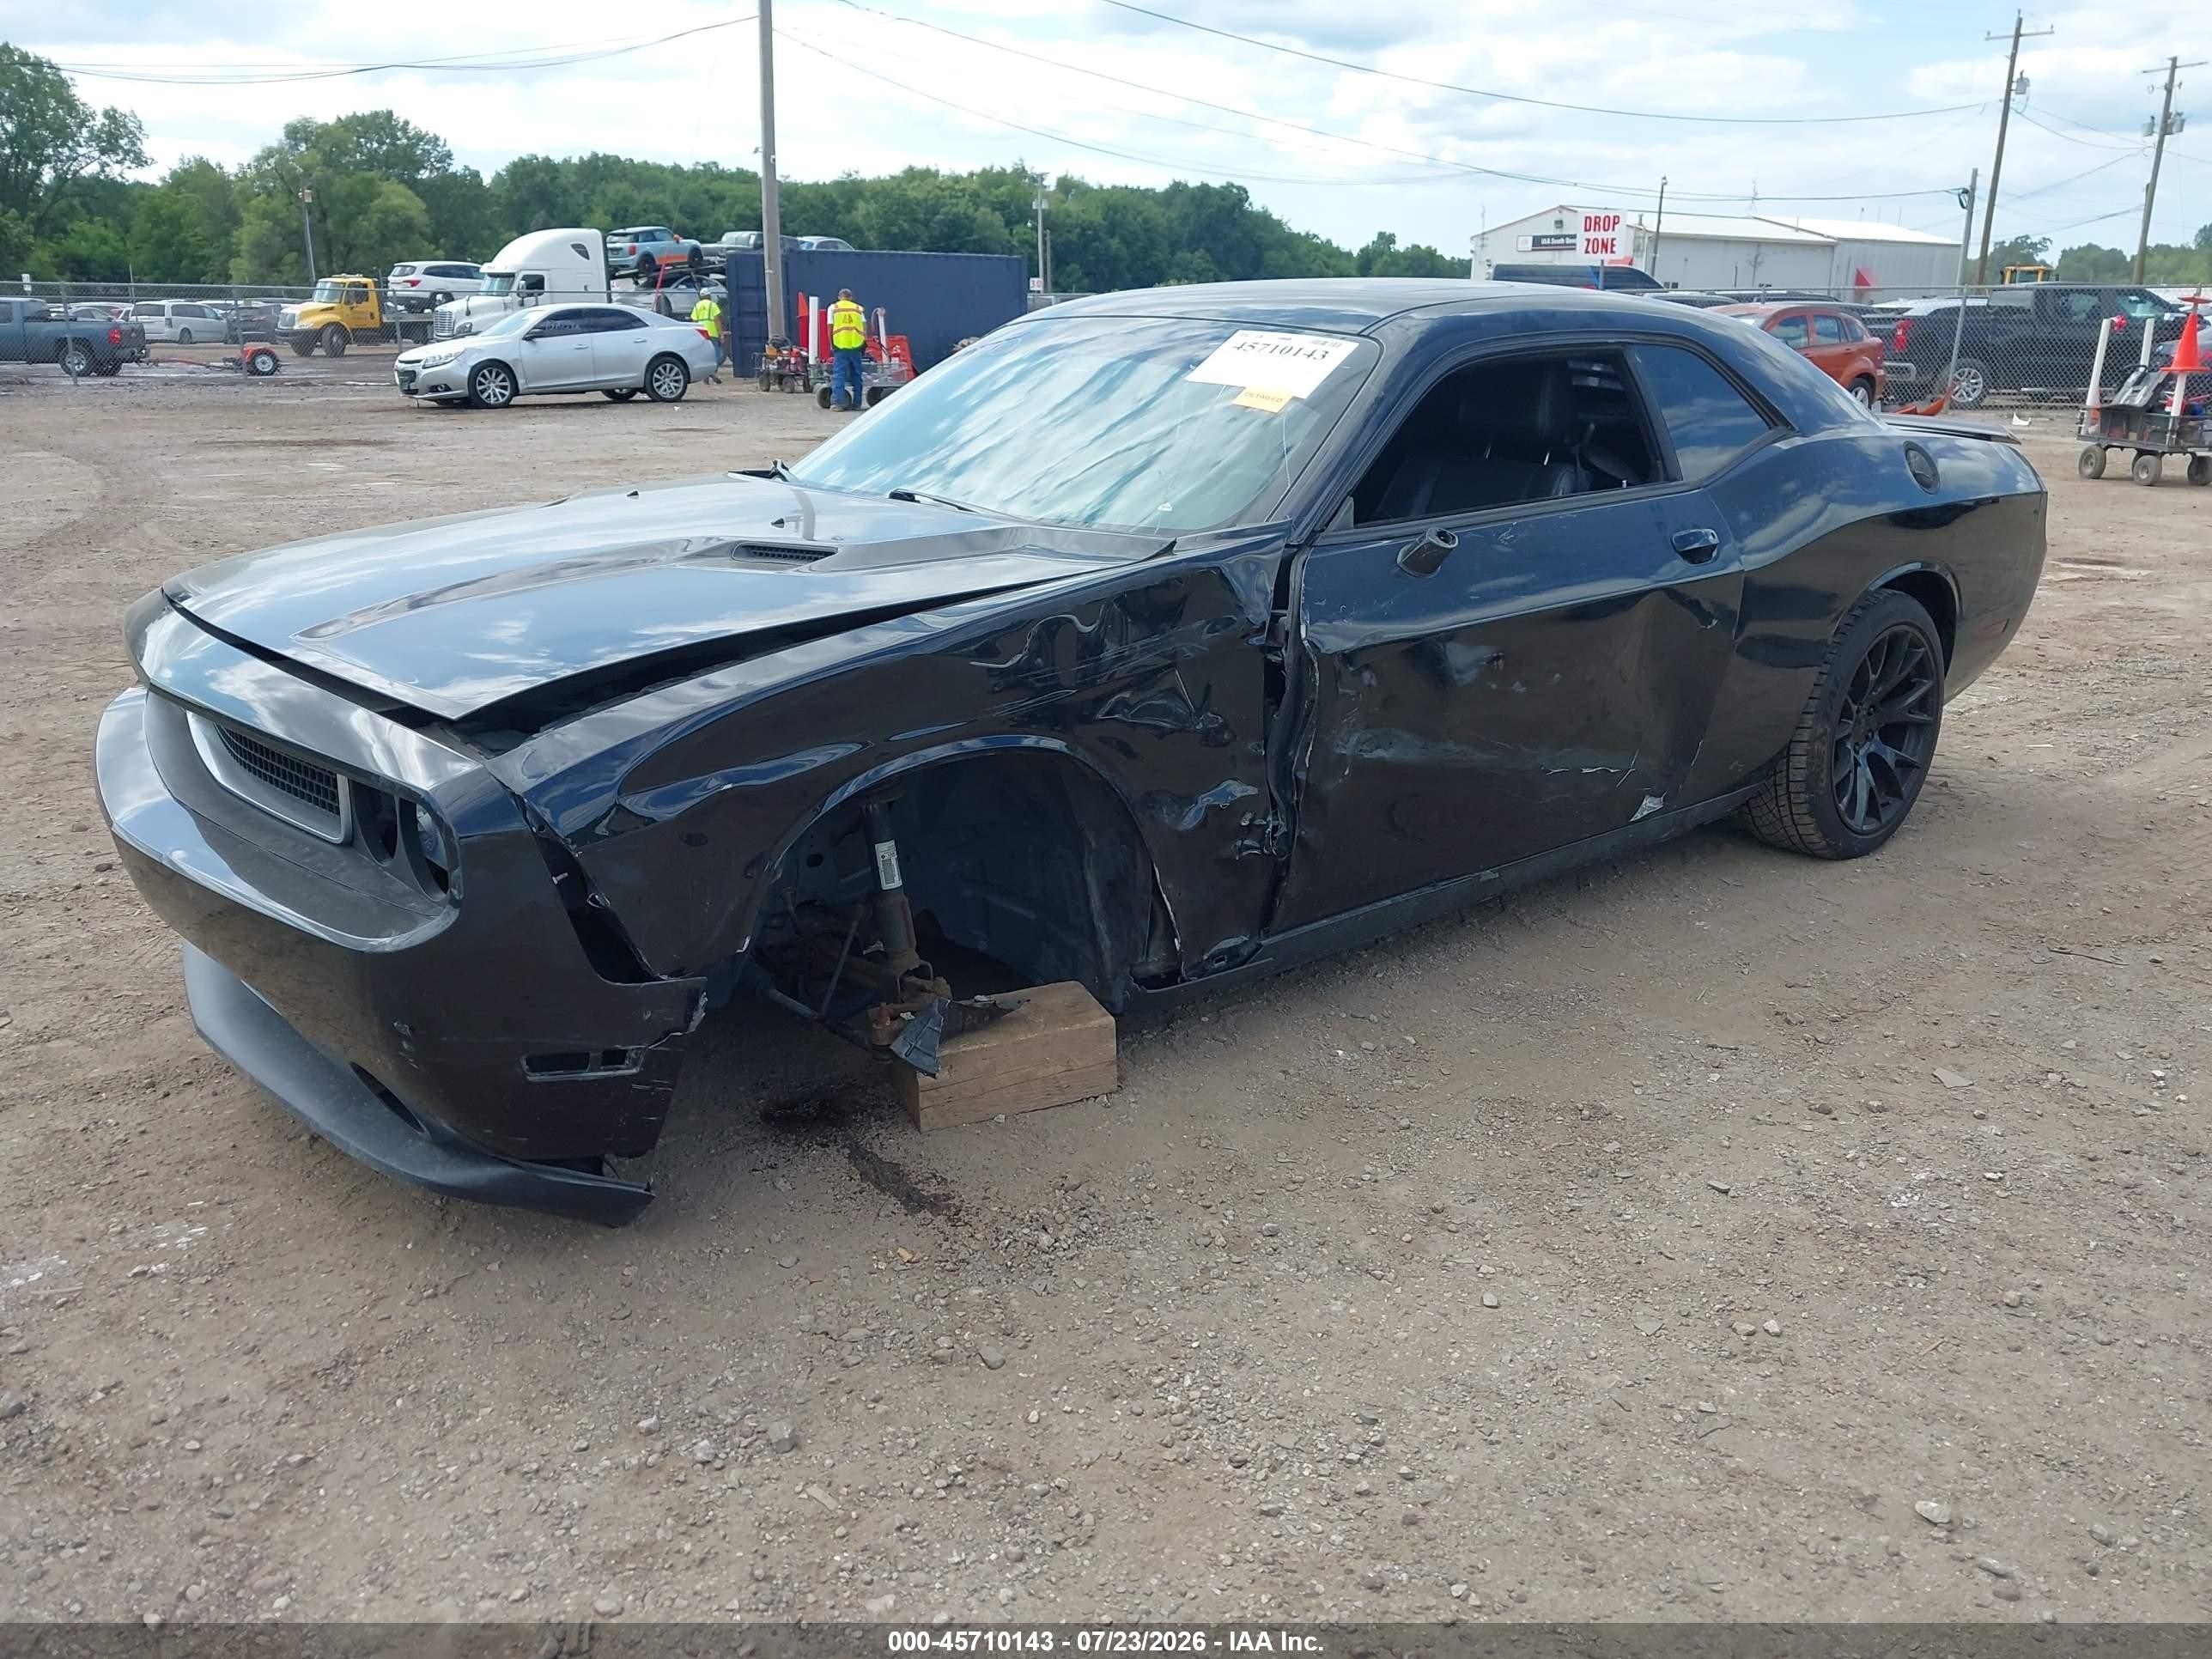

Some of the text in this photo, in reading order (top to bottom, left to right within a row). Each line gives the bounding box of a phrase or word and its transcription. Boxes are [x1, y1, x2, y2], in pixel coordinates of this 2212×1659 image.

[1584, 215, 1620, 232] DROP
[1584, 237, 1617, 254] ZONE
[1233, 342, 1329, 360] 45710143
